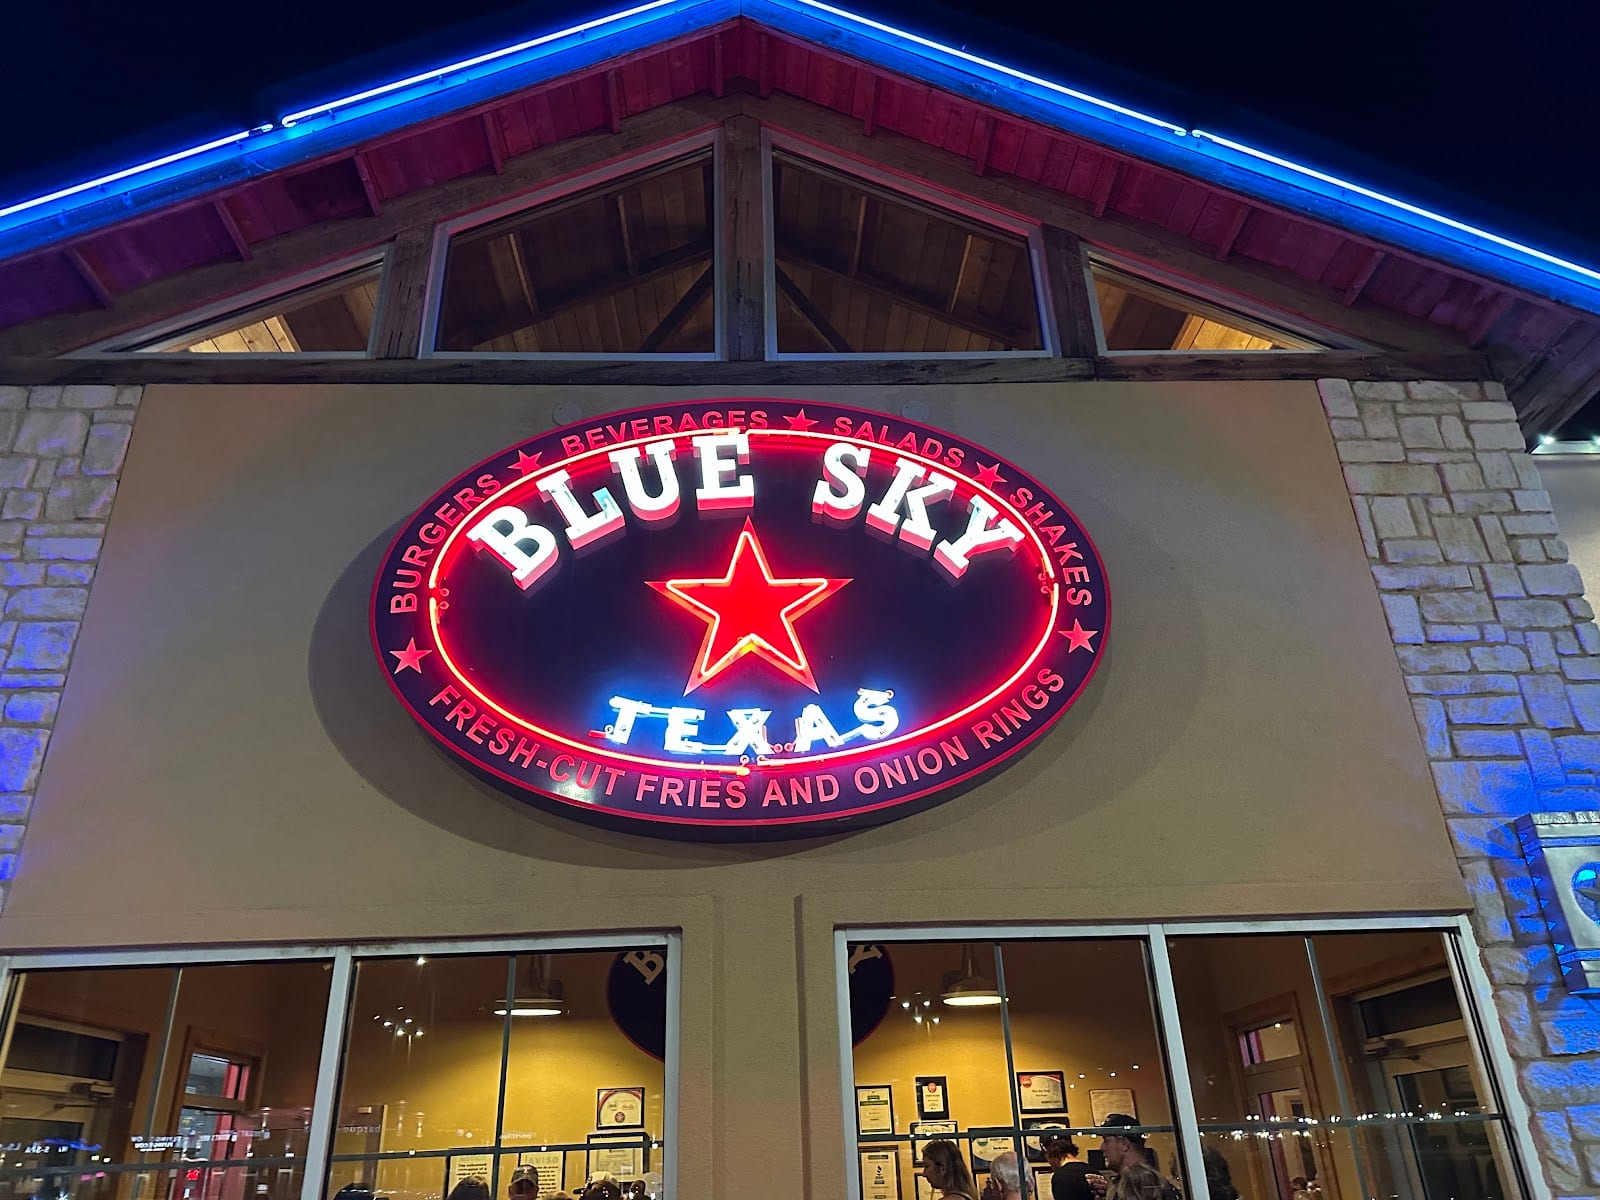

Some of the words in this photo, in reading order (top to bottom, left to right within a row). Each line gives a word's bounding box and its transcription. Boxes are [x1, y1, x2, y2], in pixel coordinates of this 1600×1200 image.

[560, 409, 768, 457] BEVERAGES
[833, 416, 965, 468] SALADS
[390, 473, 500, 614] BURGERS
[466, 433, 754, 590] BLUE
[812, 442, 1025, 578] SKY
[1010, 487, 1092, 606] SHAKES
[428, 684, 627, 796] FRESH-CUT
[636, 773, 748, 809] FRIES
[762, 774, 840, 807] AND
[854, 735, 971, 795] ONION
[971, 668, 1065, 750] RINGS
[606, 688, 900, 756] TEXAS
